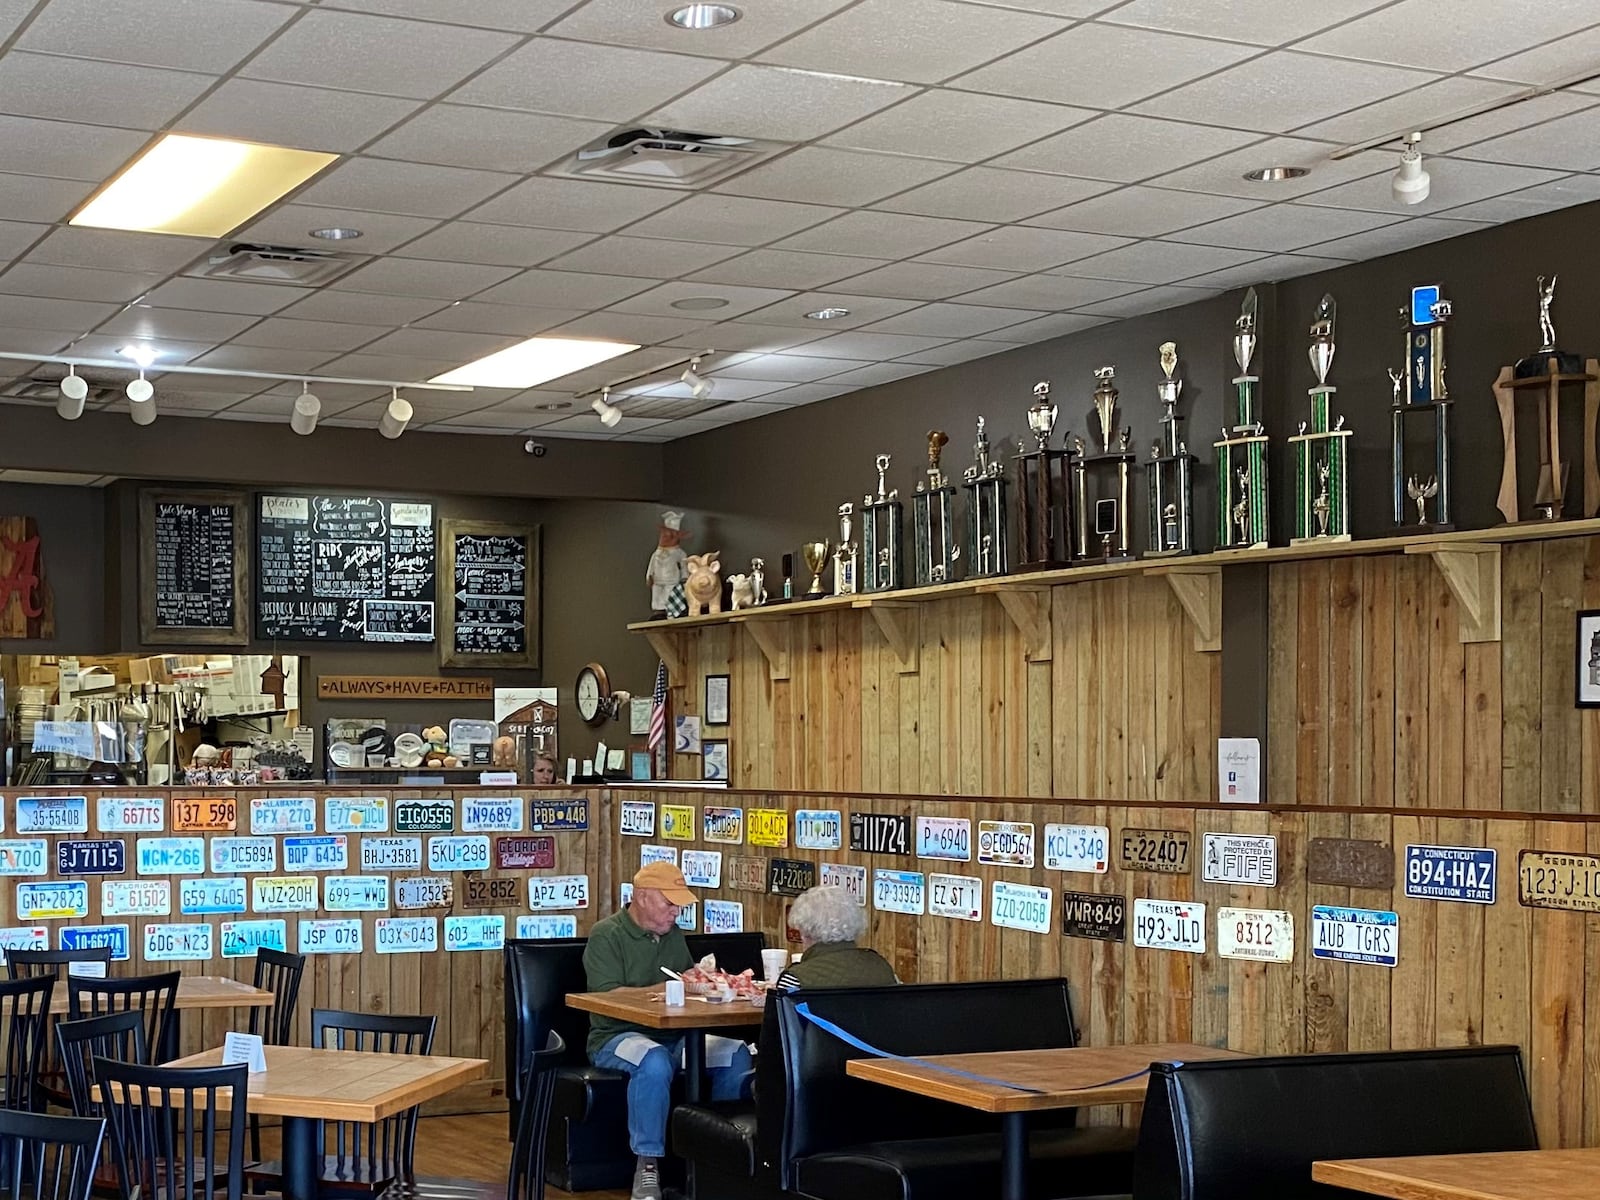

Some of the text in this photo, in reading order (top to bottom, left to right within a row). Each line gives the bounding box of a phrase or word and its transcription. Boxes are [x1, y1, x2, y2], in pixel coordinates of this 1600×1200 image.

[329, 681, 485, 694] ALWAYS HAVE FAITH
[123, 808, 160, 824] 667TS
[177, 804, 235, 823] 137 598
[256, 808, 311, 824] PFX 270
[566, 808, 586, 823] 448
[500, 841, 548, 852] GEORGIA
[940, 828, 967, 851] 6940
[1242, 840, 1270, 848] VEHICLE
[16, 850, 41, 867] 700
[232, 846, 273, 862] DC589A
[316, 846, 344, 863] 6435
[432, 844, 486, 862] 5KU 298
[1224, 846, 1262, 856] PROTECTED
[1424, 849, 1475, 860] CONNECTICUT
[501, 854, 536, 867] Bulldogs
[1224, 854, 1272, 880] FIFE
[1544, 857, 1597, 868] GEORGIA
[214, 888, 244, 905] 6405
[329, 888, 350, 902] 699
[534, 884, 585, 900] APZ 425
[934, 884, 946, 904] EZ
[951, 886, 964, 906] ST
[1408, 886, 1490, 900] CONSTITUTION STATE
[1152, 904, 1173, 914] TEXAS
[1572, 900, 1598, 908] STATE
[1334, 912, 1377, 924] NEW YORK
[304, 928, 358, 945] JSP 078
[380, 927, 434, 944] 03X 043
[448, 928, 468, 942] 603
[1138, 916, 1200, 944] H93 JLD
[1236, 922, 1272, 945] 8312
[1320, 922, 1391, 953] AUB TGRS
[149, 934, 209, 952] 6DG N23
